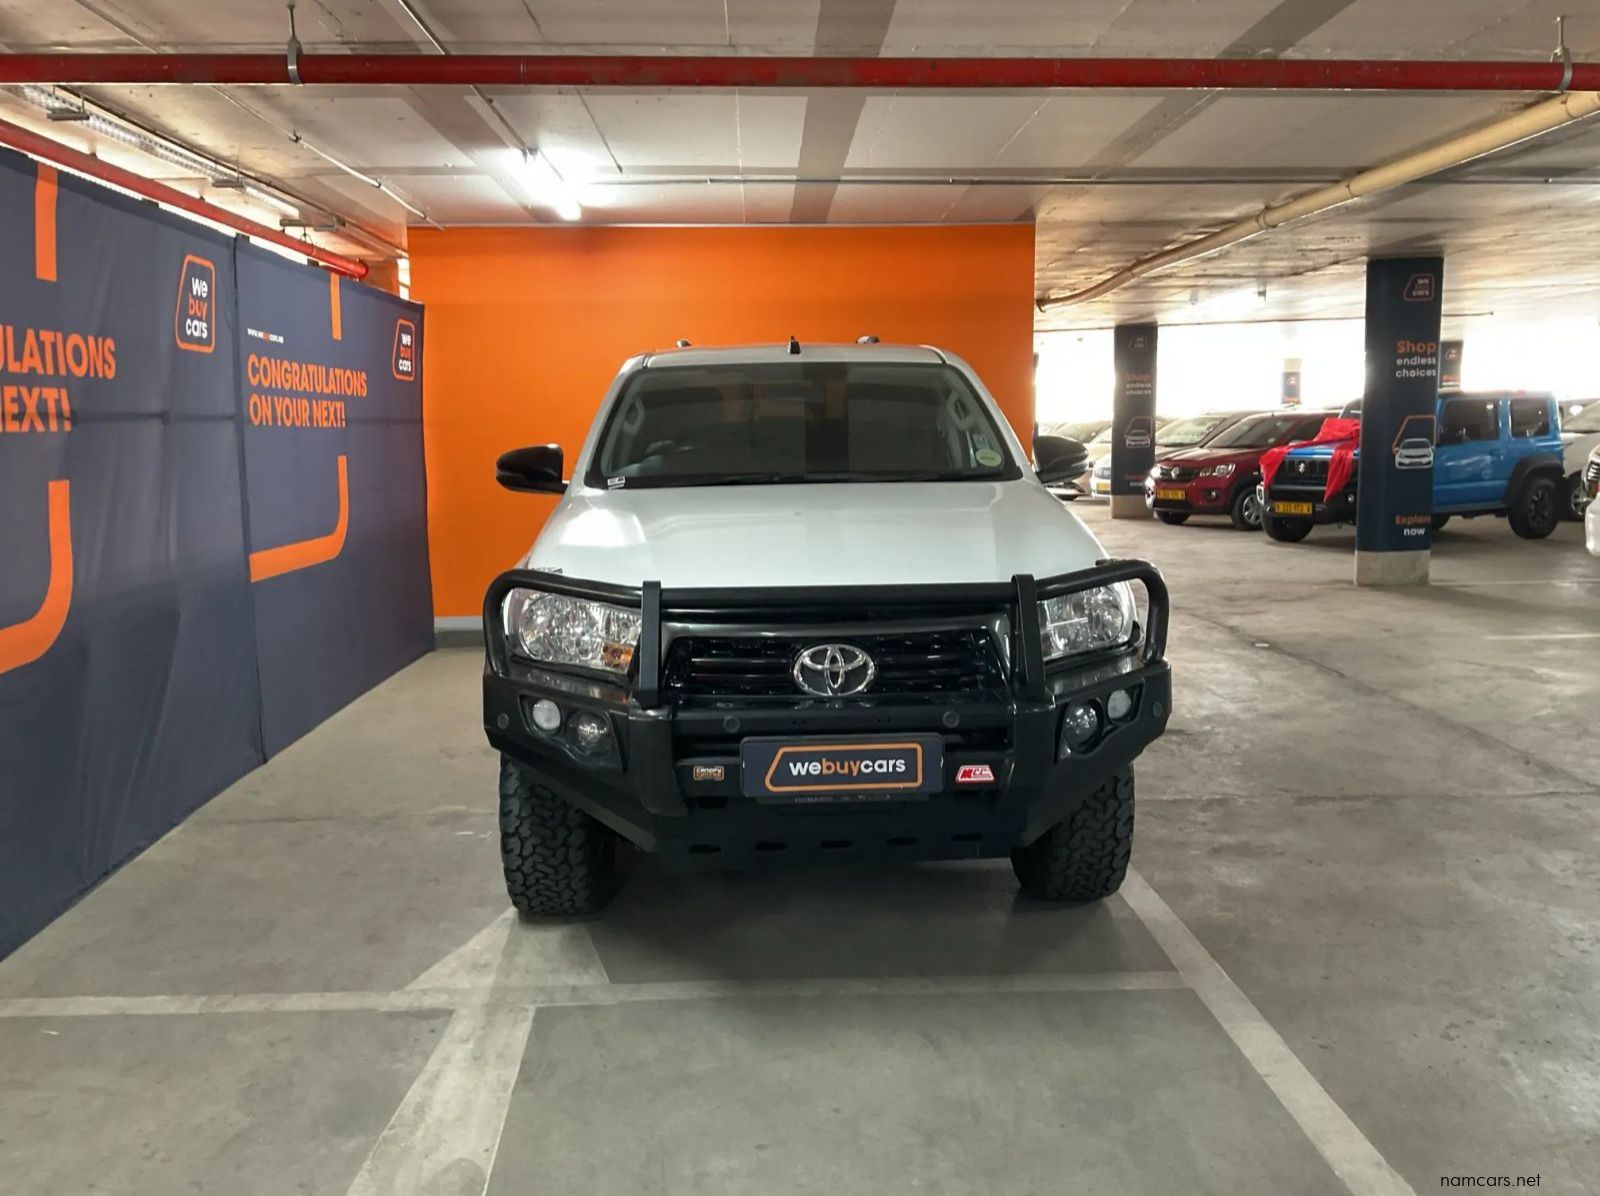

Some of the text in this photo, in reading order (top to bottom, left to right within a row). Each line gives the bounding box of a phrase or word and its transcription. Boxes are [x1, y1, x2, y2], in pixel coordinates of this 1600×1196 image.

[192, 277, 208, 298] we
[188, 293, 207, 318] buy
[186, 318, 208, 339] cars
[401, 333, 411, 346] we
[1396, 340, 1437, 356] Shop
[0, 323, 116, 380] LATIONS
[1396, 355, 1437, 366] endless
[247, 353, 368, 398] CONGRATULATIONS
[399, 359, 411, 372] cars
[1395, 367, 1437, 378] choices
[0, 385, 72, 433] EXT!
[249, 395, 347, 429] ON YOUR NEXT!
[1403, 528, 1426, 537] now
[789, 757, 907, 778] webuycars
